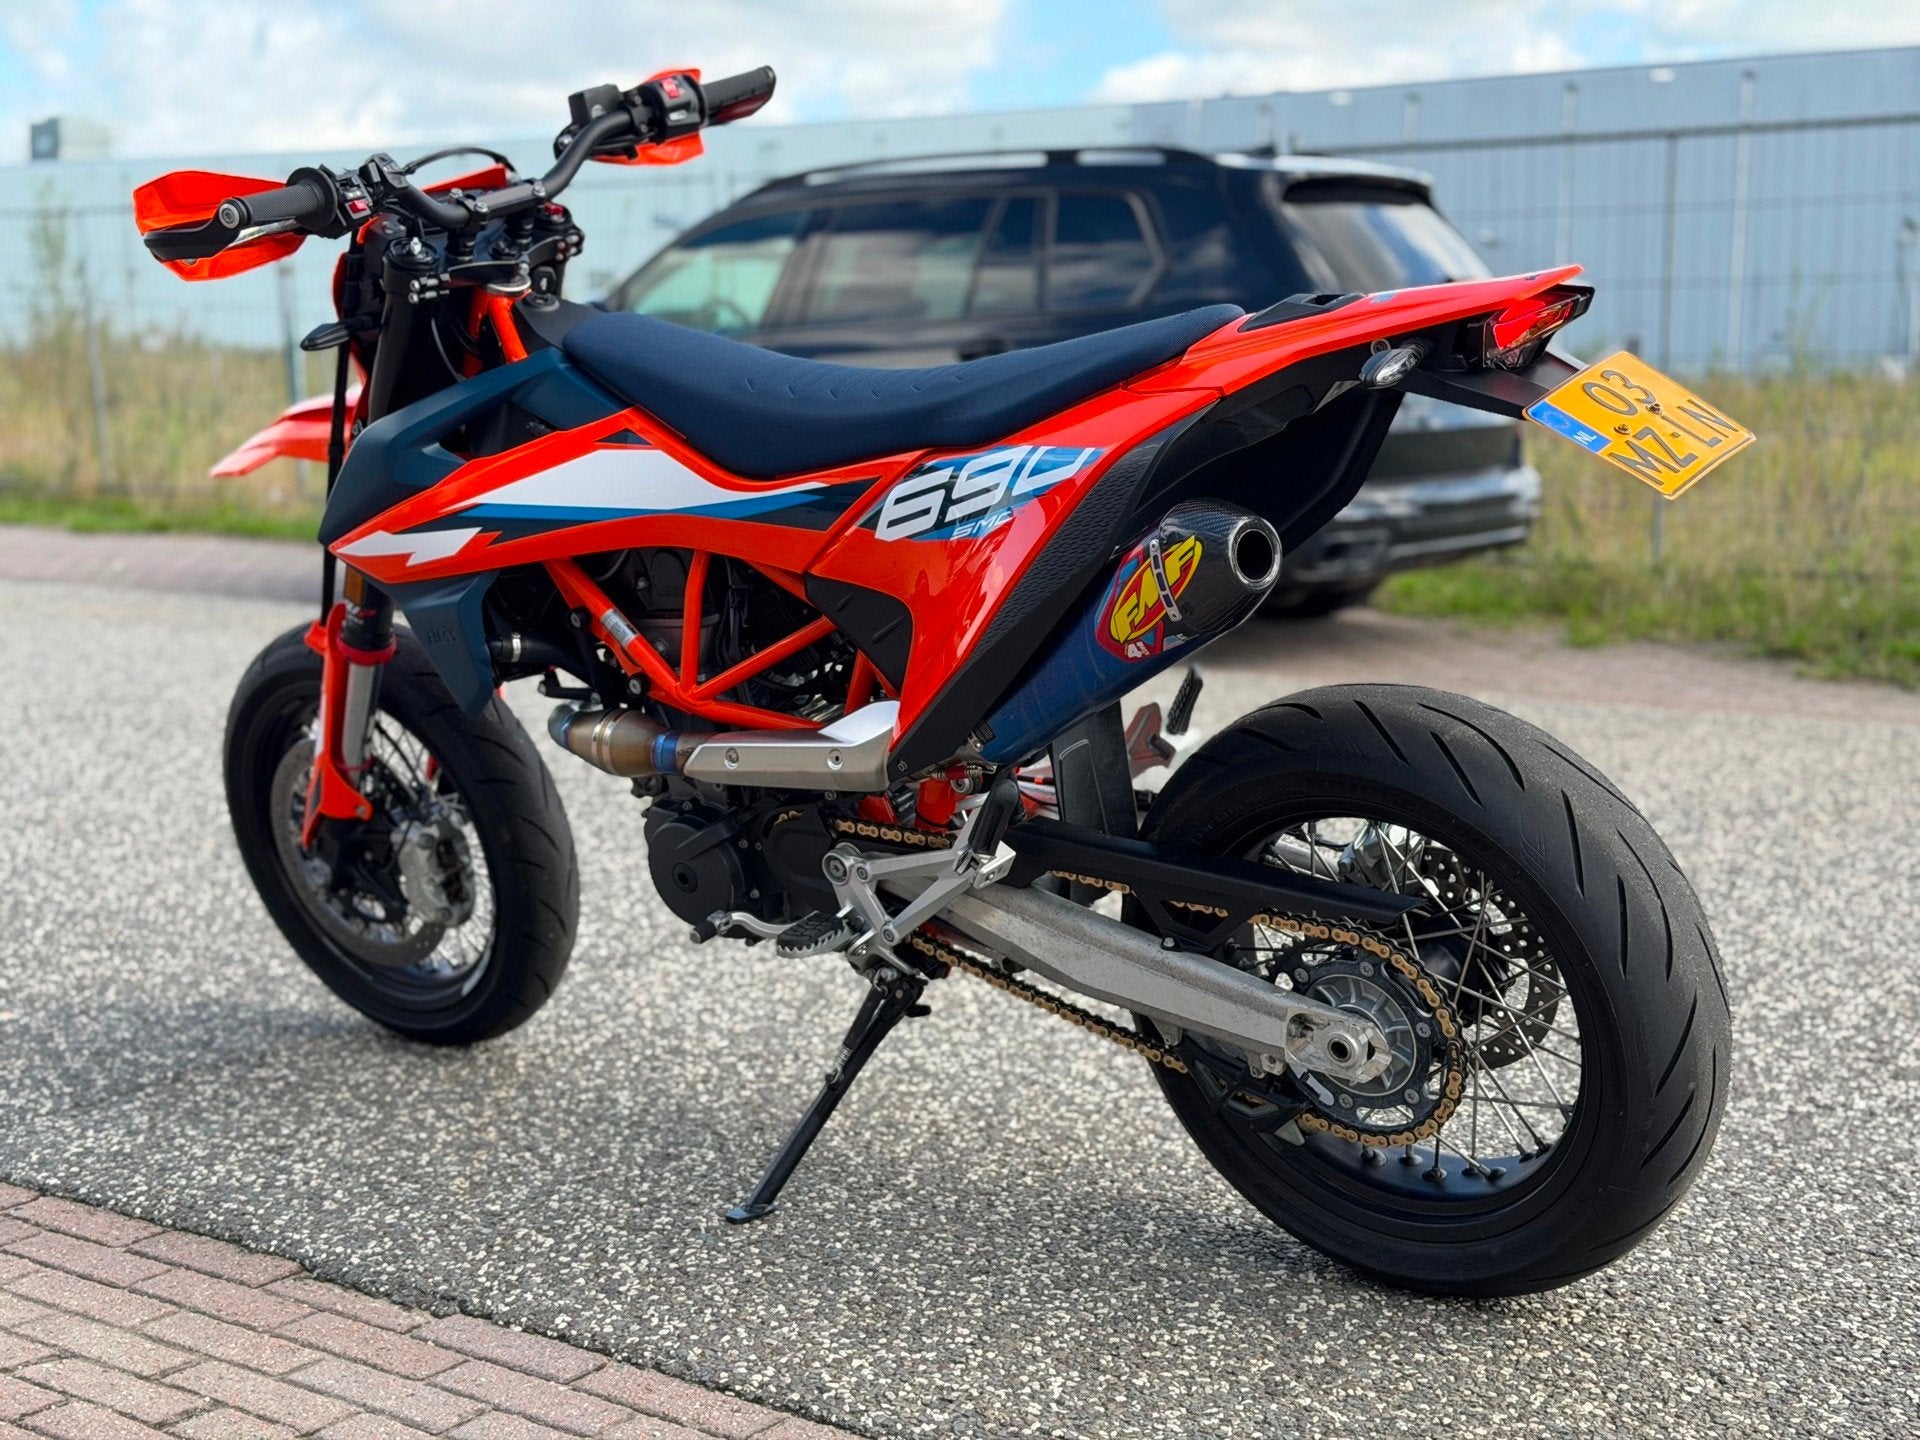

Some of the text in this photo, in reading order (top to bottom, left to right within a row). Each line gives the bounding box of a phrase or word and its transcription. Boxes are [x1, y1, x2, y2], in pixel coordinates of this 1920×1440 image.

[1583, 369, 1657, 416] 03
[1572, 430, 1598, 445] NL
[1608, 398, 1740, 486] MZ-LN
[874, 445, 1096, 542] 690
[950, 510, 1014, 541] SMC
[1113, 534, 1197, 644] FMF
